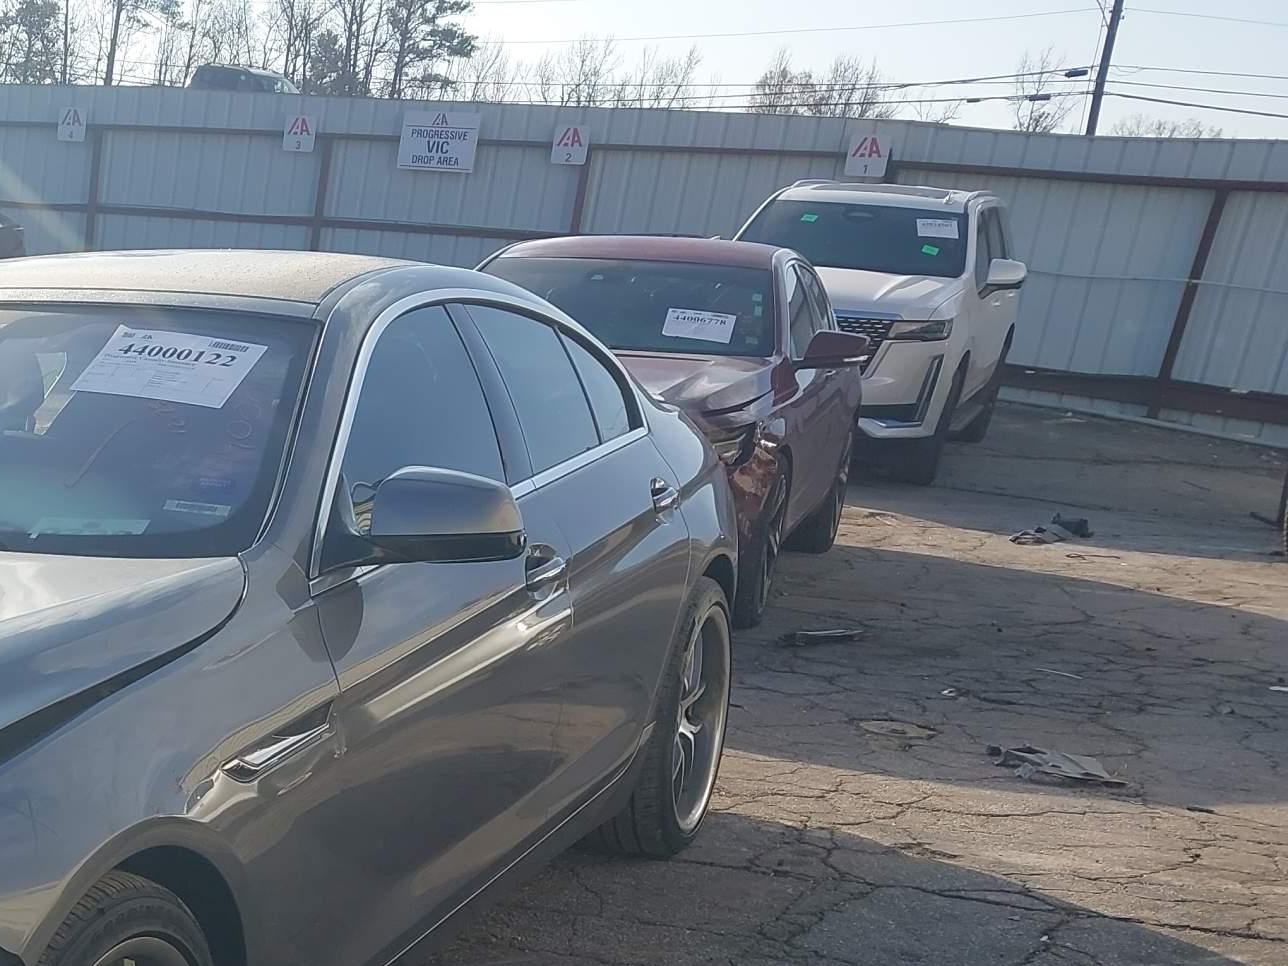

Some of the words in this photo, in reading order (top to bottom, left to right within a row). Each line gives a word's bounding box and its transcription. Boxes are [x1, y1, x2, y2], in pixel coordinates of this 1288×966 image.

[411, 128, 469, 141] PROGRESSIVE
[295, 140, 301, 150] 3
[426, 140, 450, 155] VIC
[411, 154, 434, 165] DROP
[436, 156, 459, 167] AREA
[565, 152, 572, 163] 2
[118, 343, 239, 367] 44000122
